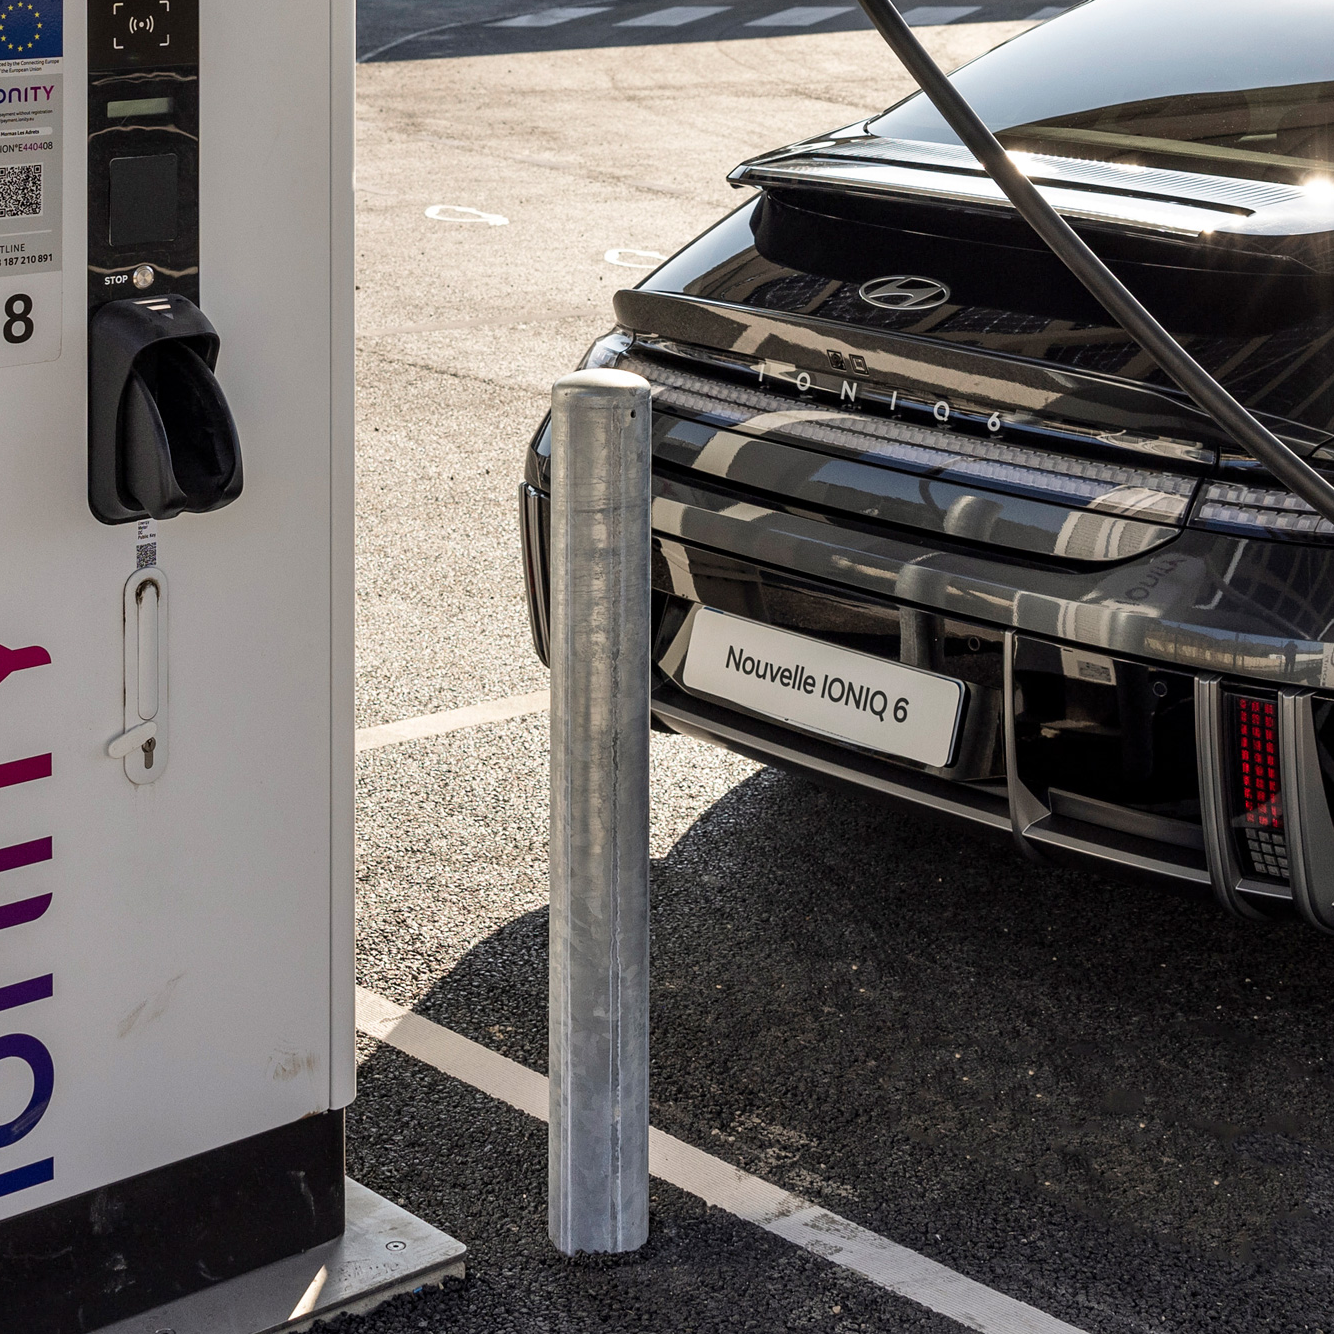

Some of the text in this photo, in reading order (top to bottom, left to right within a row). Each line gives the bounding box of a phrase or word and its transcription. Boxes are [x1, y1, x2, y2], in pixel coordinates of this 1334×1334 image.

[3, 257, 19, 266] 187
[20, 255, 37, 265] 210
[37, 253, 53, 263] 891
[104, 275, 129, 286] STOP
[2, 293, 34, 344] 8
[758, 363, 1001, 432] IONIQ 6
[725, 645, 910, 723] Nouvelle IONIQ 6
